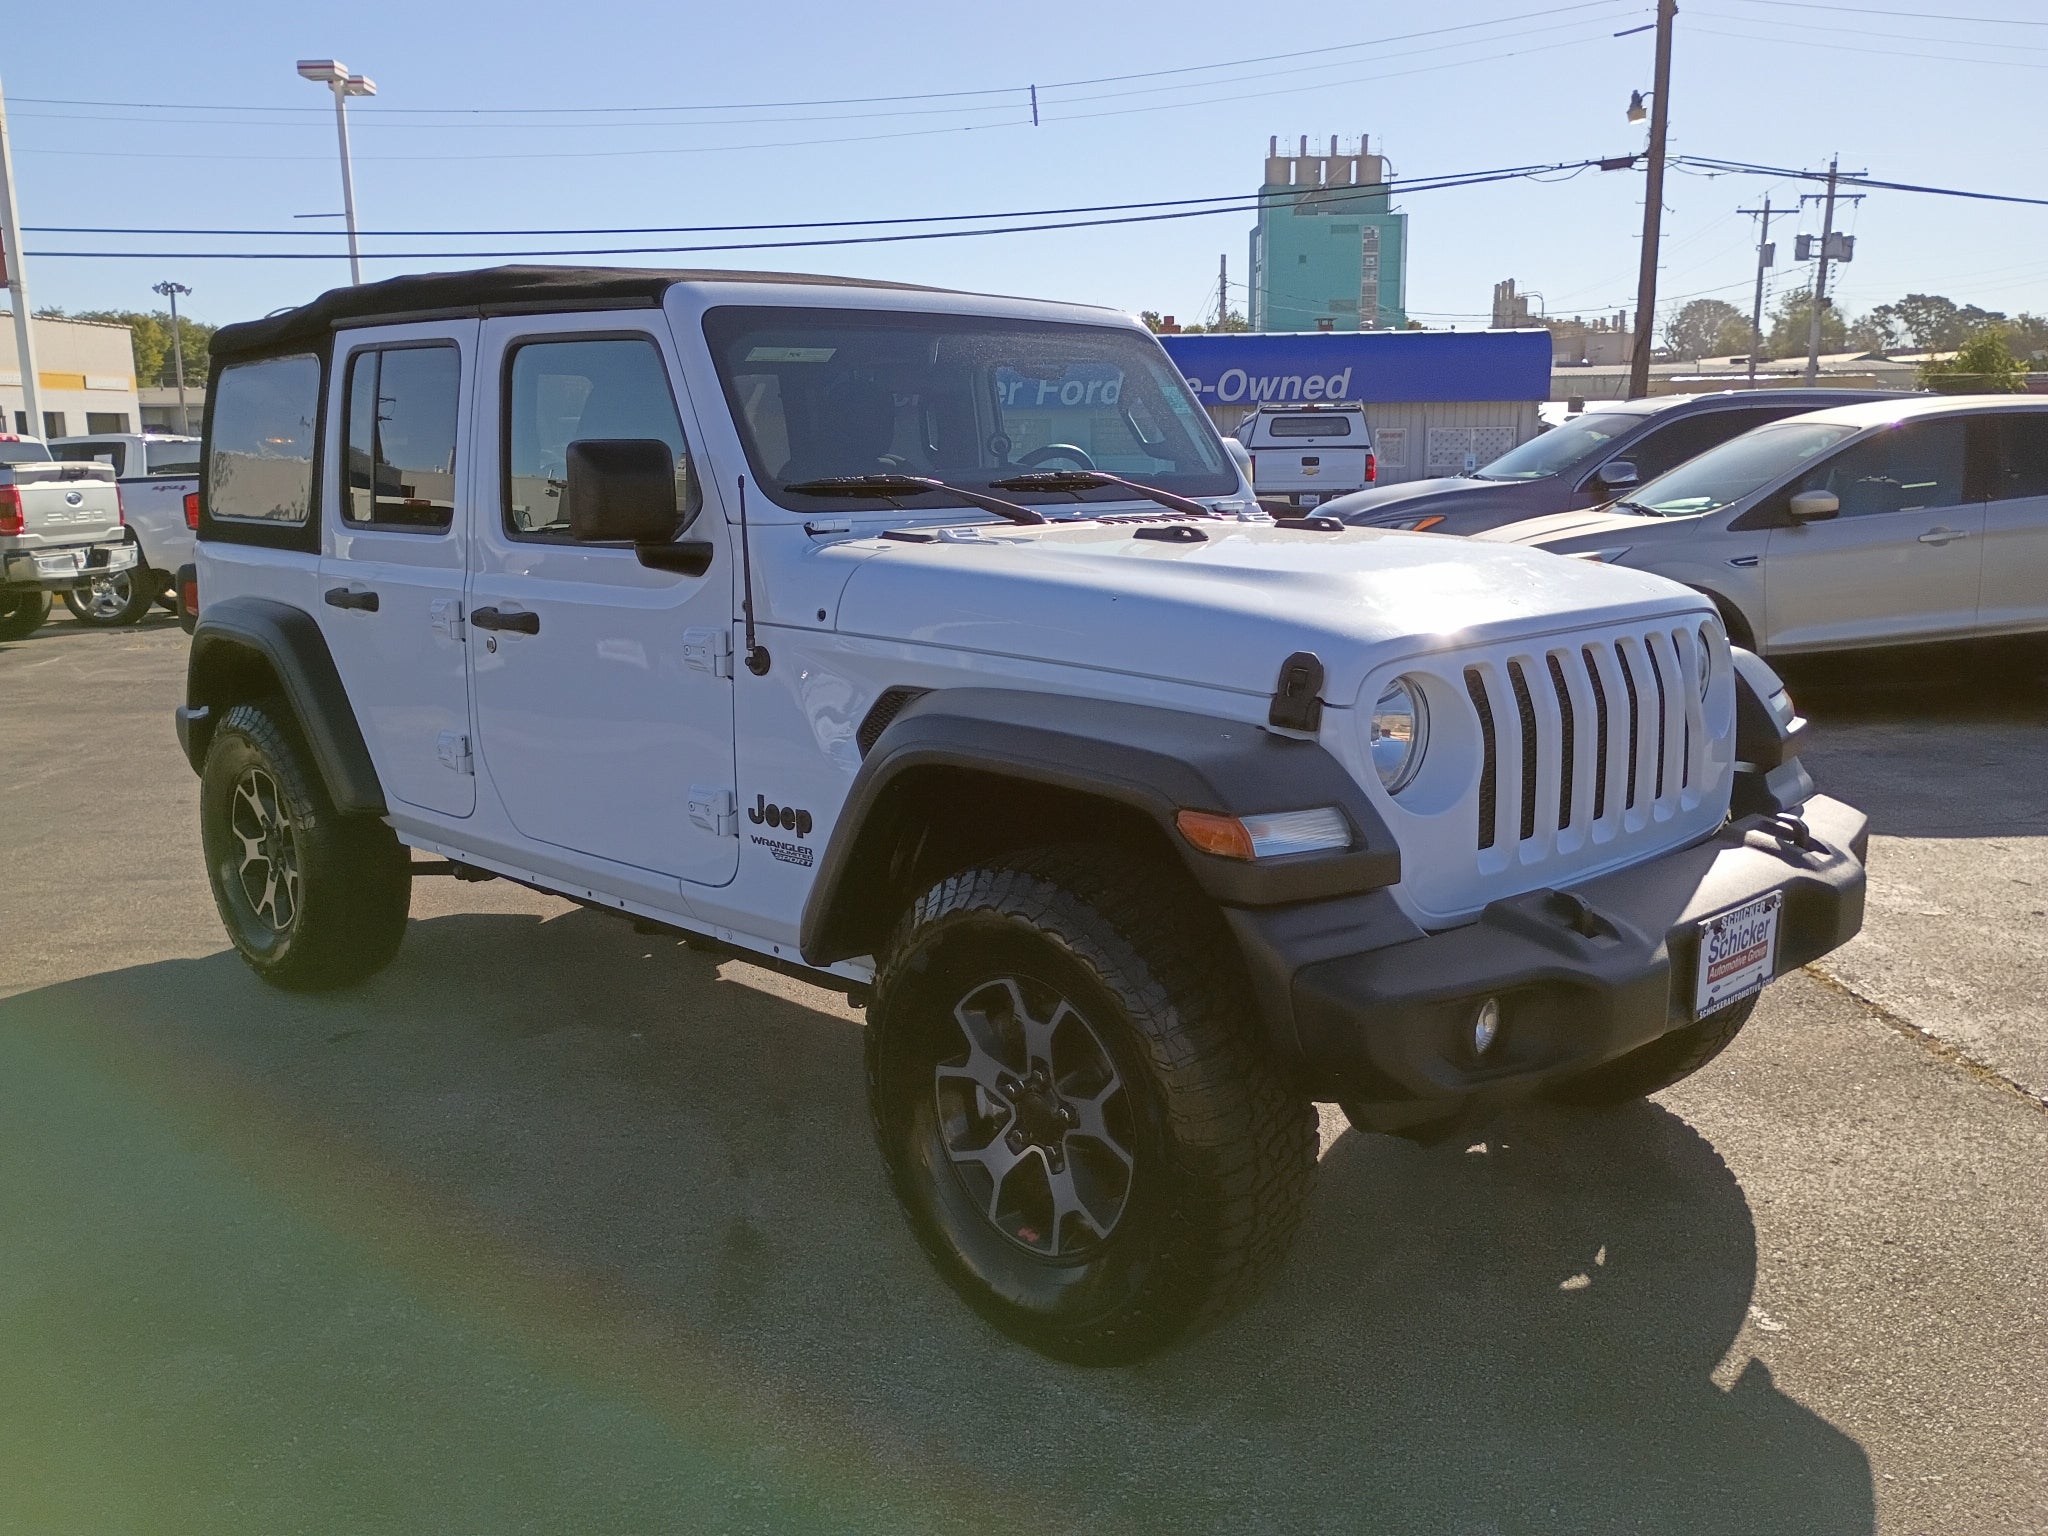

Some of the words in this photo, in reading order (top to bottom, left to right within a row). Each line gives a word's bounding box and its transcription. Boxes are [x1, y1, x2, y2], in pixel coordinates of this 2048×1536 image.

[1035, 374, 1125, 405] Ford
[748, 794, 812, 839] Jeep
[750, 834, 813, 856] WRANGLER
[774, 853, 813, 867] SPORT
[1721, 901, 1766, 927] SCHICKER
[1708, 919, 1771, 964] Schicker
[1708, 953, 1748, 979] Automotive
